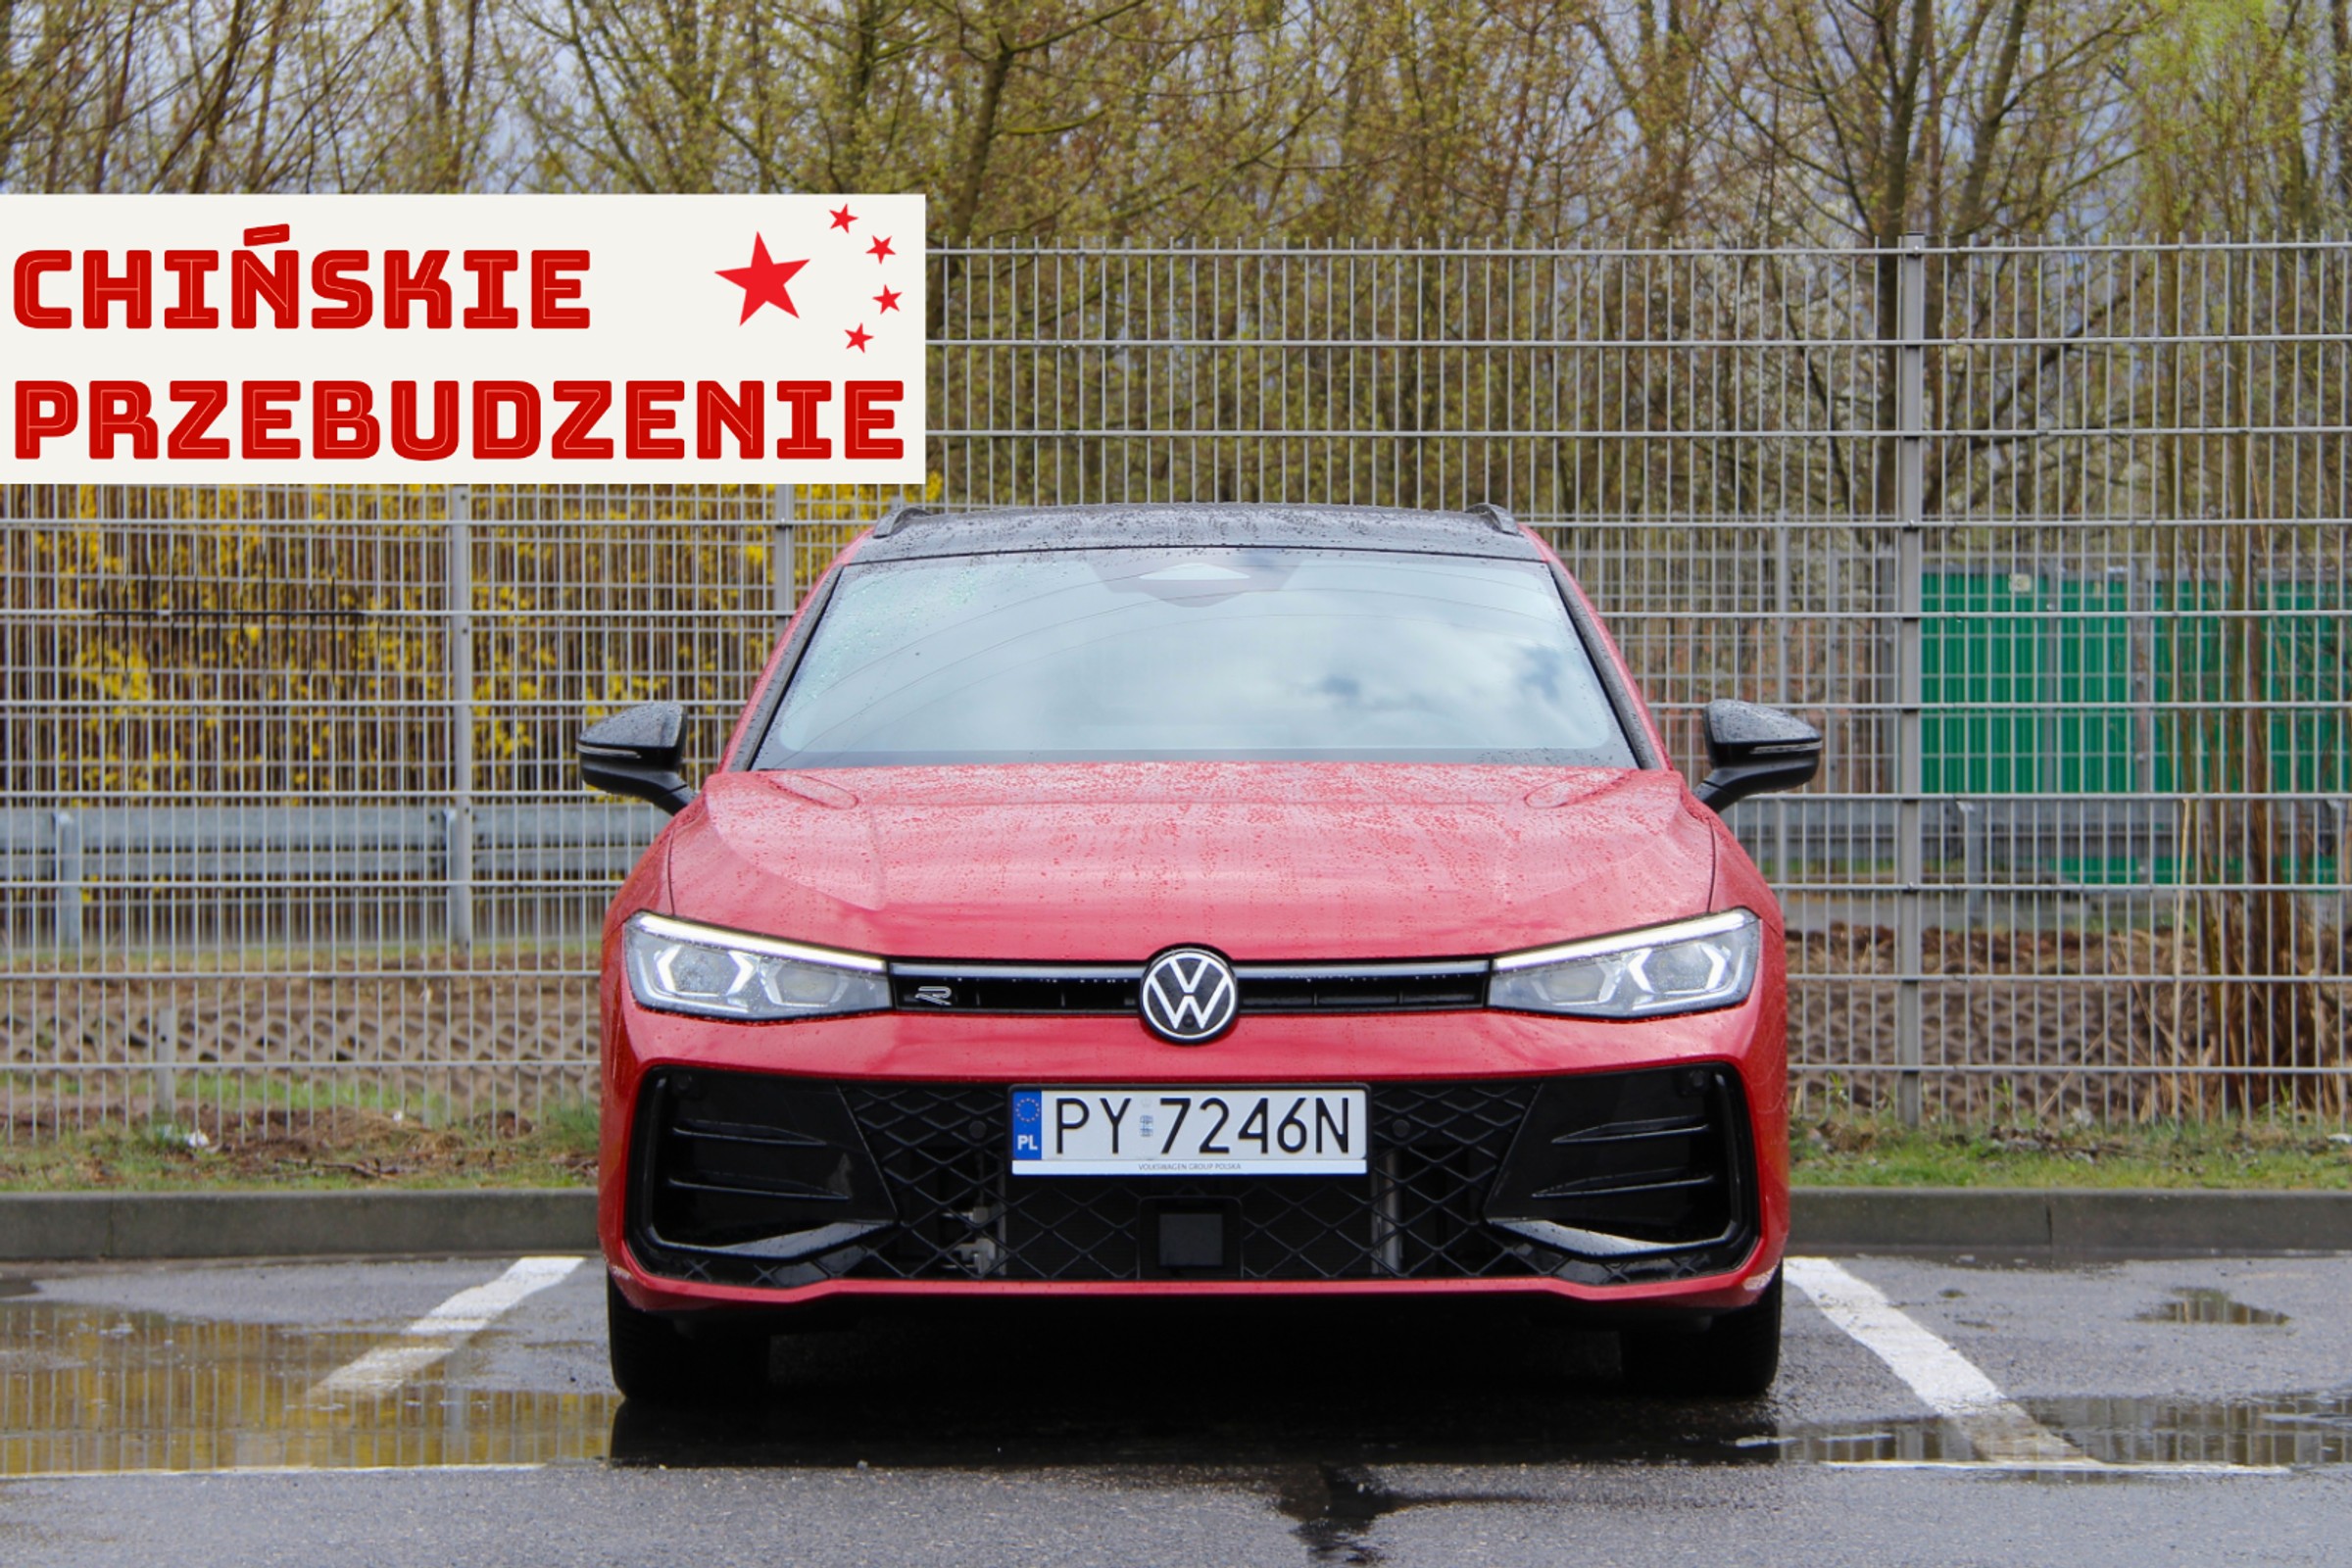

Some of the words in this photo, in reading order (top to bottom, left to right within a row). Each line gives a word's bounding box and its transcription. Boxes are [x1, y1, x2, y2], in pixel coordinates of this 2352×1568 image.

[1017, 1135, 1038, 1150] PL
[1056, 1098, 1131, 1153] PY
[1160, 1098, 1348, 1153] 7246N
